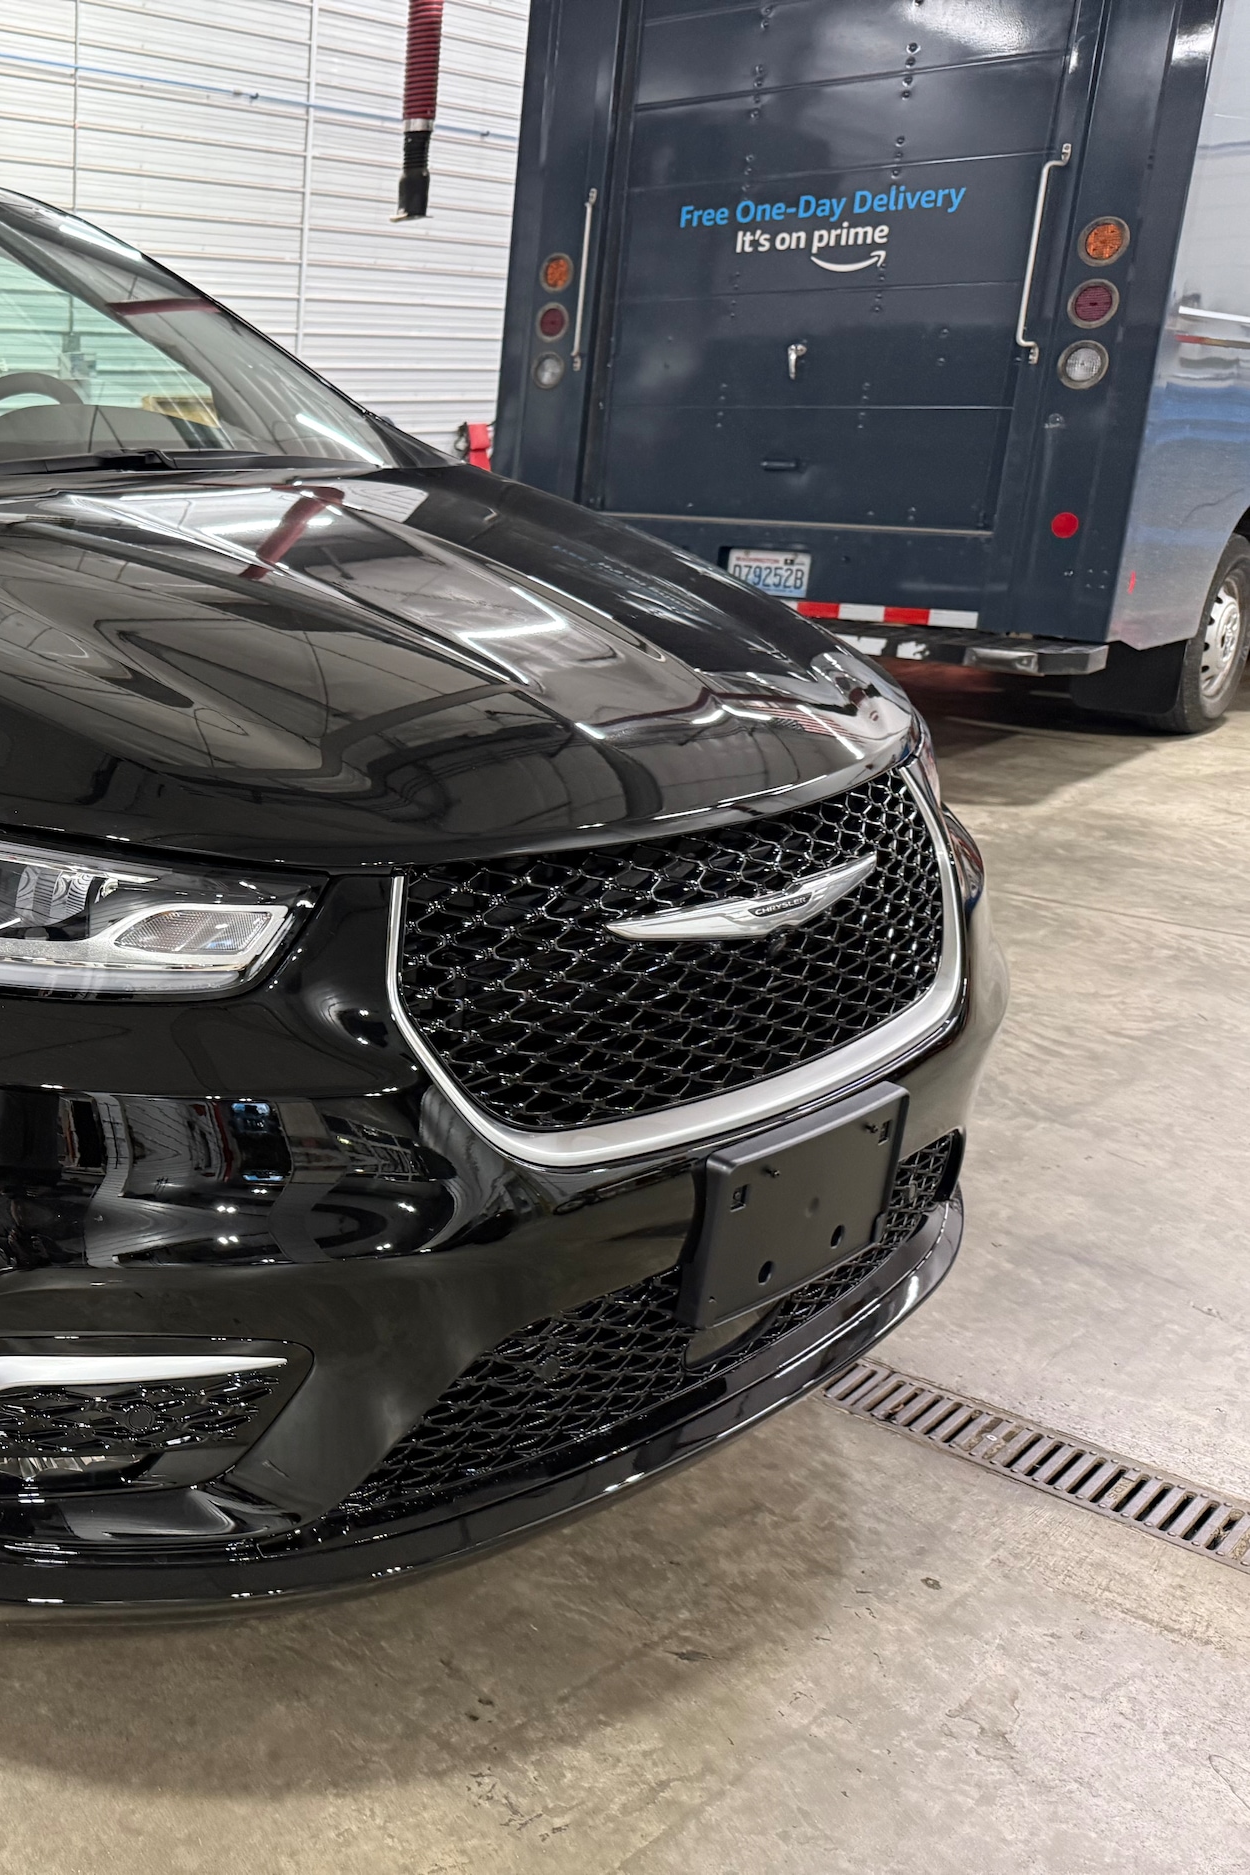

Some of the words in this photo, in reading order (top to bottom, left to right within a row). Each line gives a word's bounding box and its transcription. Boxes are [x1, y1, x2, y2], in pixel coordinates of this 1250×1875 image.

[680, 205, 729, 228] Free
[735, 194, 847, 224] One-Day
[853, 185, 967, 213] Delivery
[736, 229, 770, 253] It's
[775, 230, 806, 249] on
[811, 221, 890, 253] prime
[755, 897, 807, 915] CHRYSLER
